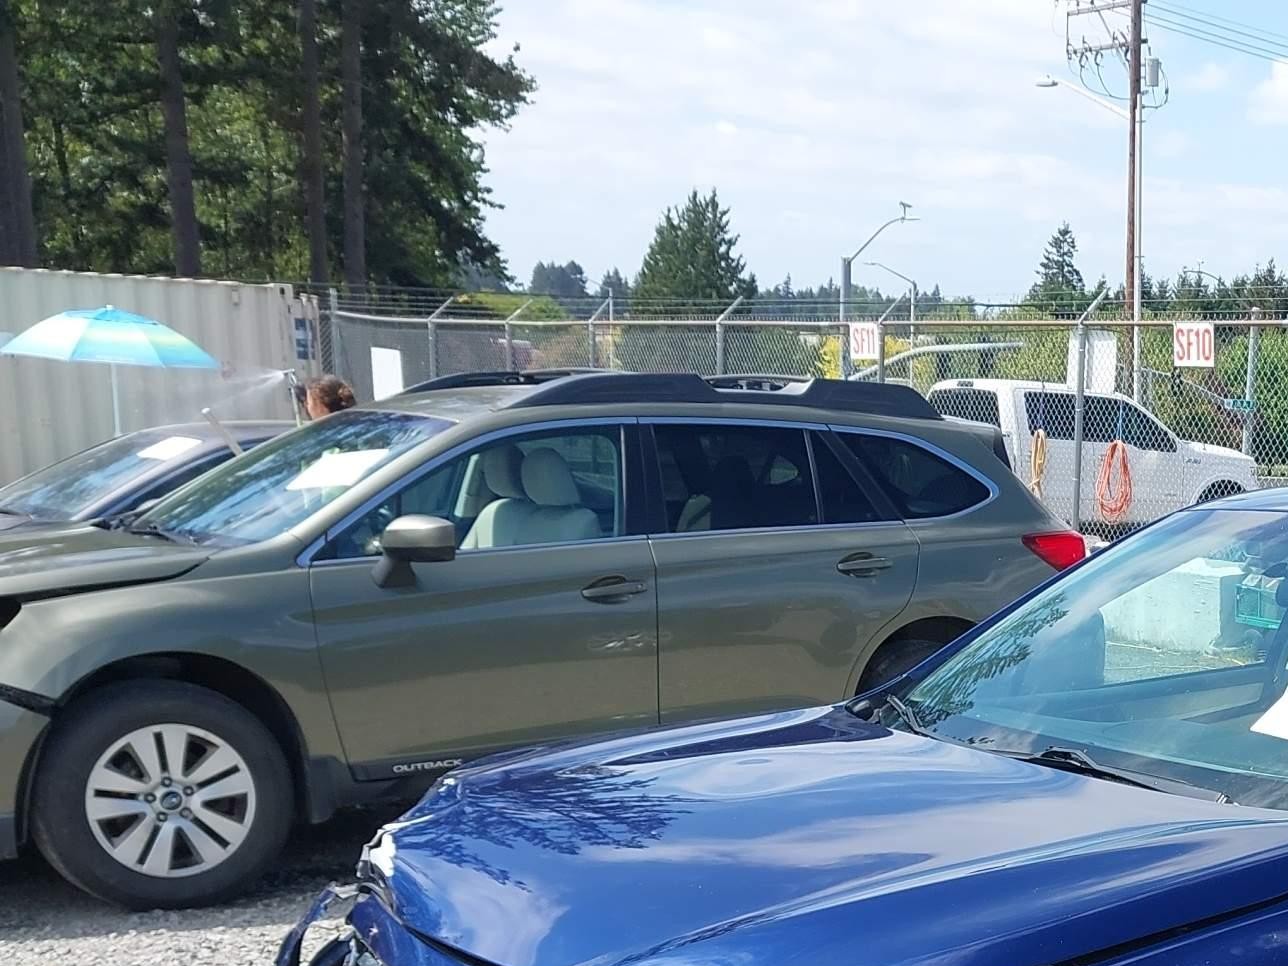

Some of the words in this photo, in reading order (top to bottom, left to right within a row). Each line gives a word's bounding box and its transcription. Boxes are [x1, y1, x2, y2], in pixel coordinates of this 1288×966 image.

[853, 328, 876, 354] SF11
[1175, 327, 1214, 362] SF10
[393, 759, 462, 773] OUTBACK
